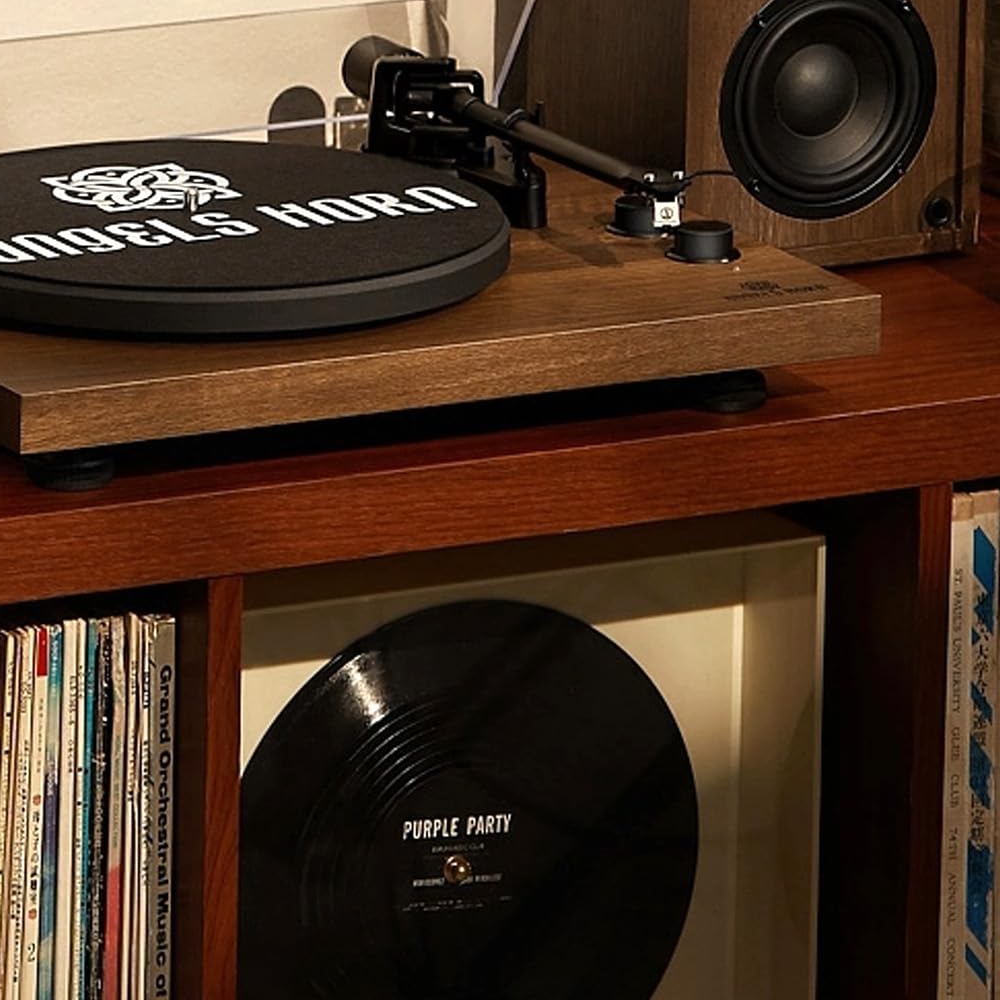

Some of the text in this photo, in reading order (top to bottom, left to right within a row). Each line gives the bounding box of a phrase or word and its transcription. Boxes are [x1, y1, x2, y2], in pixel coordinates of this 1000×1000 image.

[159, 664, 173, 744] Grand
[953, 638, 963, 713] UNIVERSITY
[952, 728, 961, 761] GLEE
[156, 750, 172, 887] Orchestral
[950, 773, 960, 808] CLUB
[403, 813, 512, 840] PURPLE PARTY
[947, 873, 958, 926] ANNUAL
[155, 892, 169, 968] Music
[945, 938, 957, 998] CONCERT
